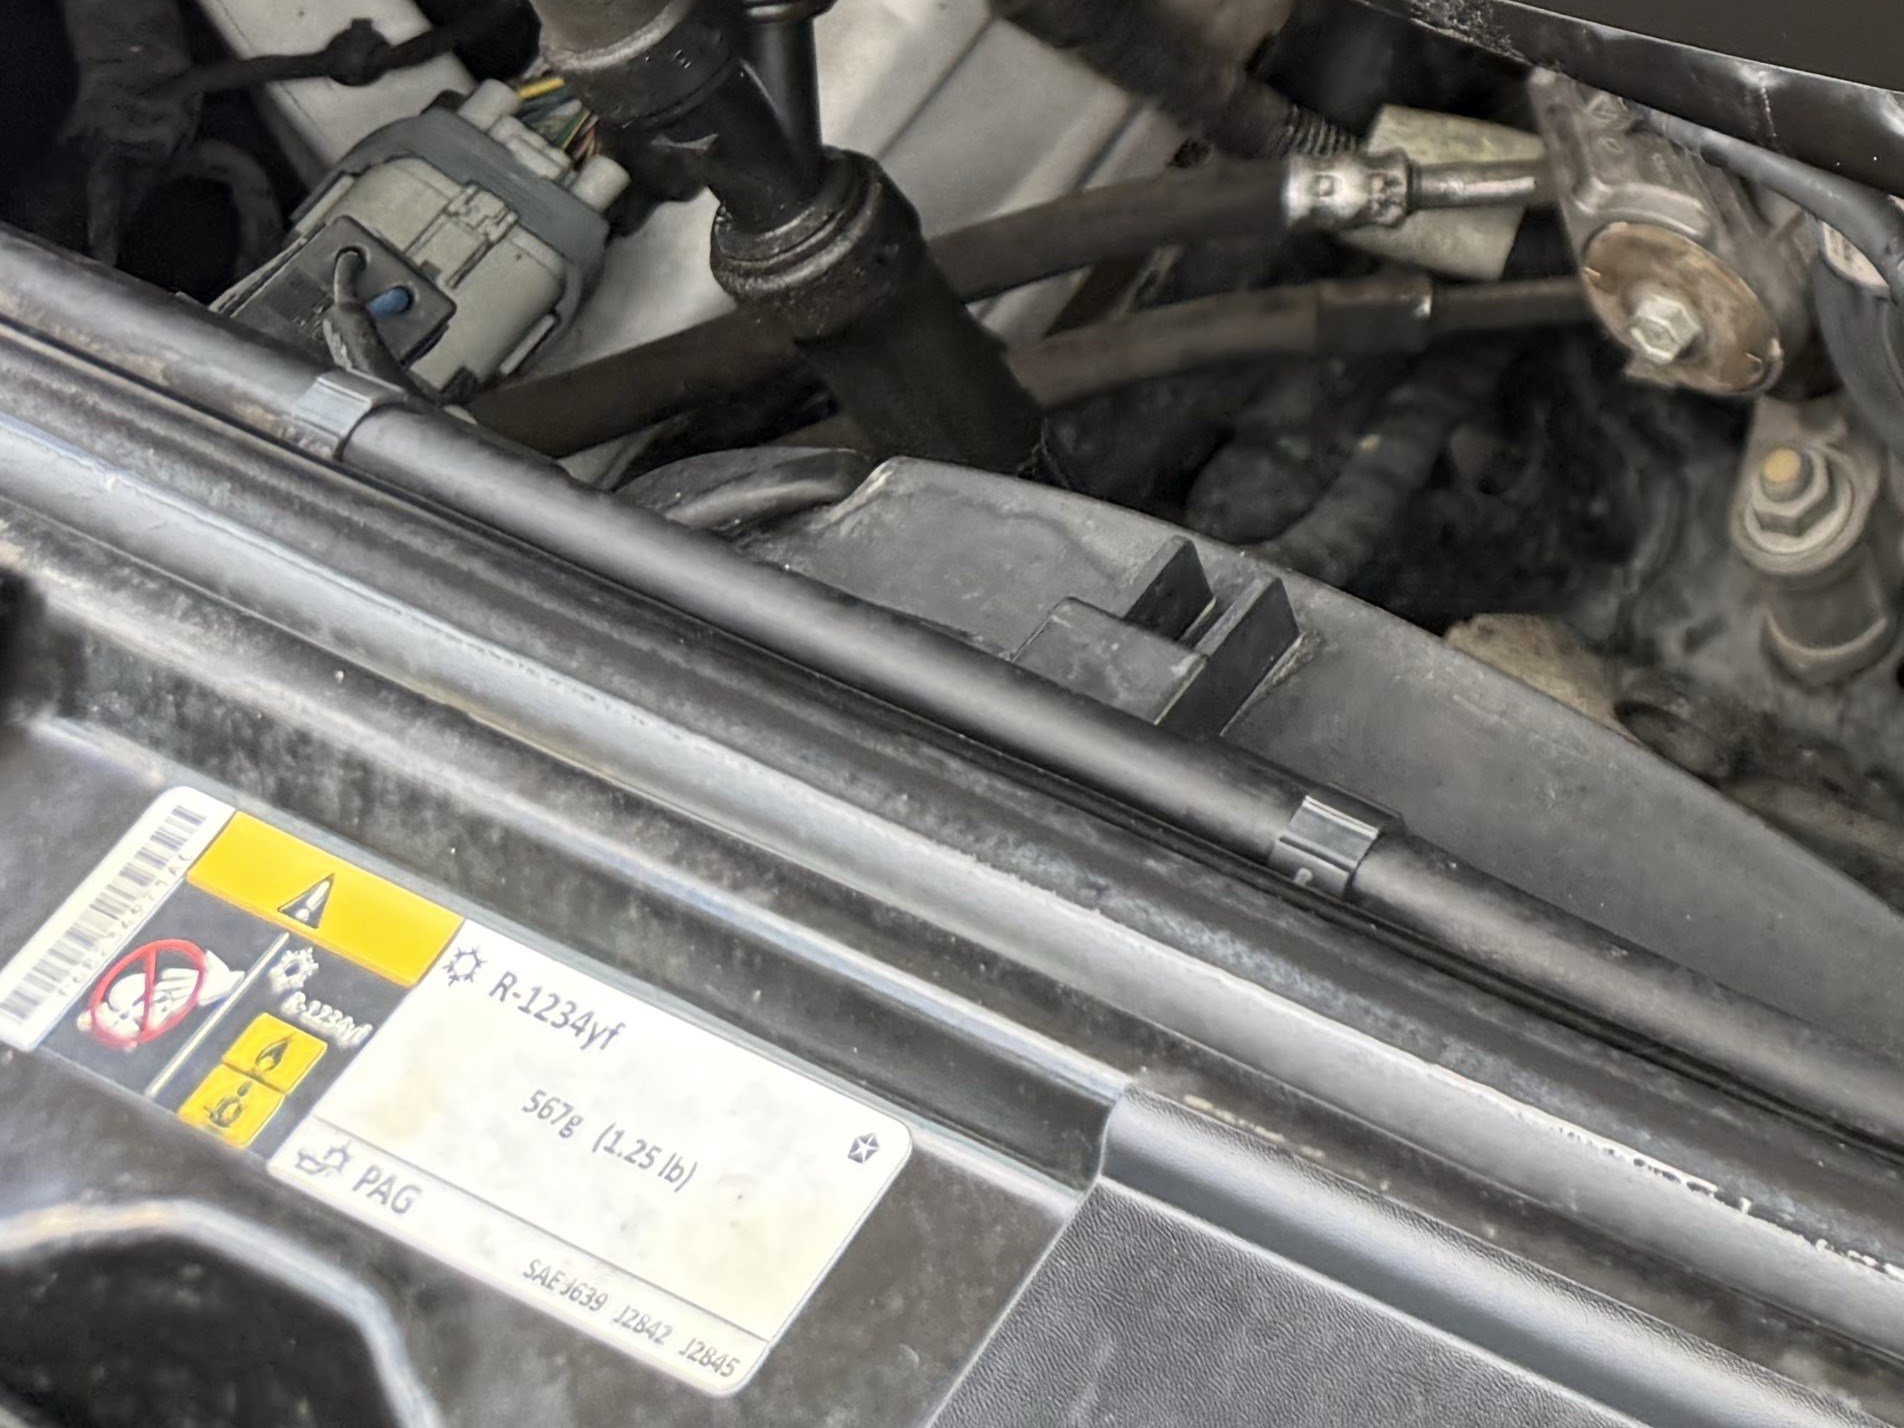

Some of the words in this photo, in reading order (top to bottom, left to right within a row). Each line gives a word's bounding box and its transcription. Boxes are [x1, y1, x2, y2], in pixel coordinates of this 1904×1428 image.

[489, 970, 626, 1050] R-1234yf
[521, 1089, 584, 1139] 567g
[592, 1122, 662, 1170] (1.25
[657, 1152, 698, 1192] lb)
[352, 1164, 423, 1214] PAG
[612, 1304, 673, 1345] J2842
[679, 1337, 740, 1377] J2845
